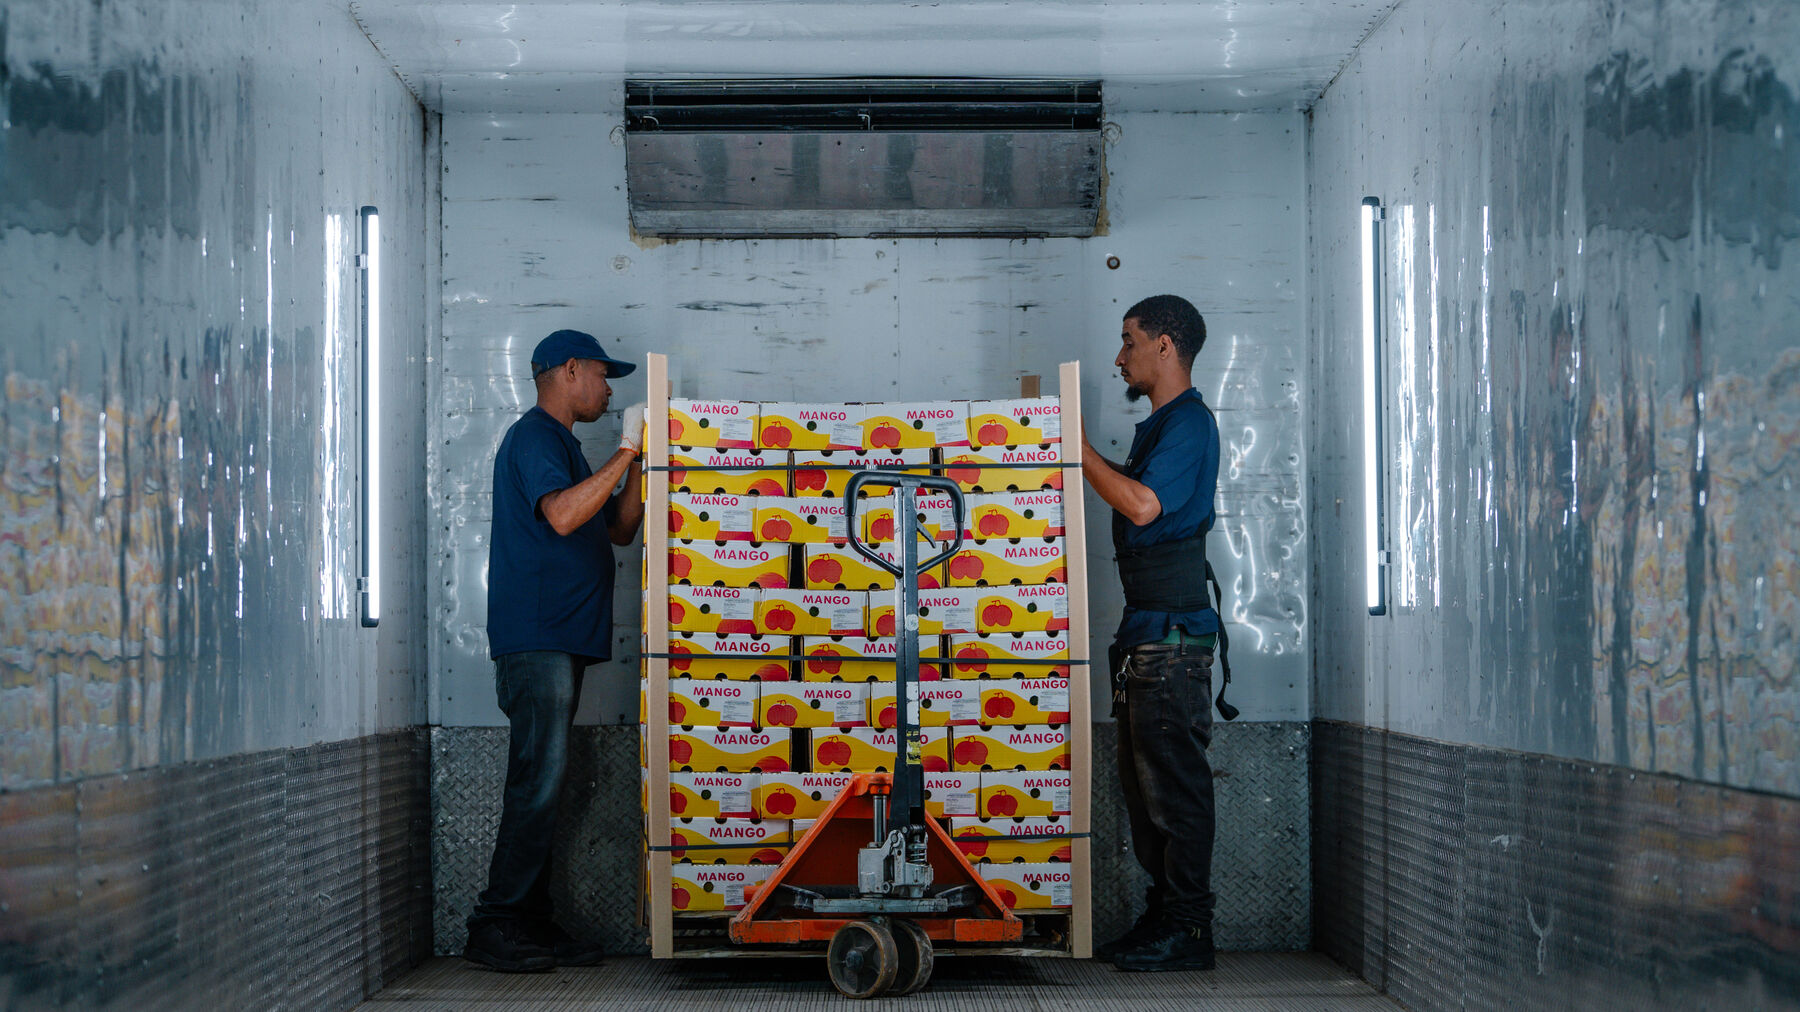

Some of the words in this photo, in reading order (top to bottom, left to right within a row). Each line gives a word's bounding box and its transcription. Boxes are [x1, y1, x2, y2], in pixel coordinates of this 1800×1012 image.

[691, 404, 739, 415] MANGO
[906, 409, 954, 420] MANGO
[1013, 406, 1060, 417] MANGO
[799, 410, 847, 421] MANGO
[709, 455, 765, 467] MANGO
[1002, 451, 1057, 463] MANGO
[691, 495, 739, 507] MANGO
[918, 499, 953, 510] ANGO
[1014, 495, 1062, 506] MANGO
[799, 505, 846, 515] MANGO
[714, 549, 769, 561] MANGO
[1005, 546, 1060, 558] MANGO
[692, 588, 740, 599] MANGO
[1018, 586, 1065, 597] MANGO
[802, 594, 850, 605] MANGO
[714, 641, 771, 653] MANGO
[863, 643, 897, 654] MAN
[1010, 640, 1066, 651] MANGO
[1020, 679, 1068, 690] MANGO
[693, 687, 741, 697] MANGO
[804, 689, 851, 699] MANGO
[714, 734, 770, 745] MANGO
[1009, 733, 1064, 744] MANGO
[694, 777, 742, 787] MANGO
[802, 777, 849, 787] MANGO
[925, 779, 962, 789] ANGO
[1023, 778, 1072, 788] MANGO
[709, 827, 766, 838] MANGO
[1010, 824, 1065, 836] MANGO
[697, 872, 745, 881] MANGO
[1022, 873, 1070, 883] MANGO
